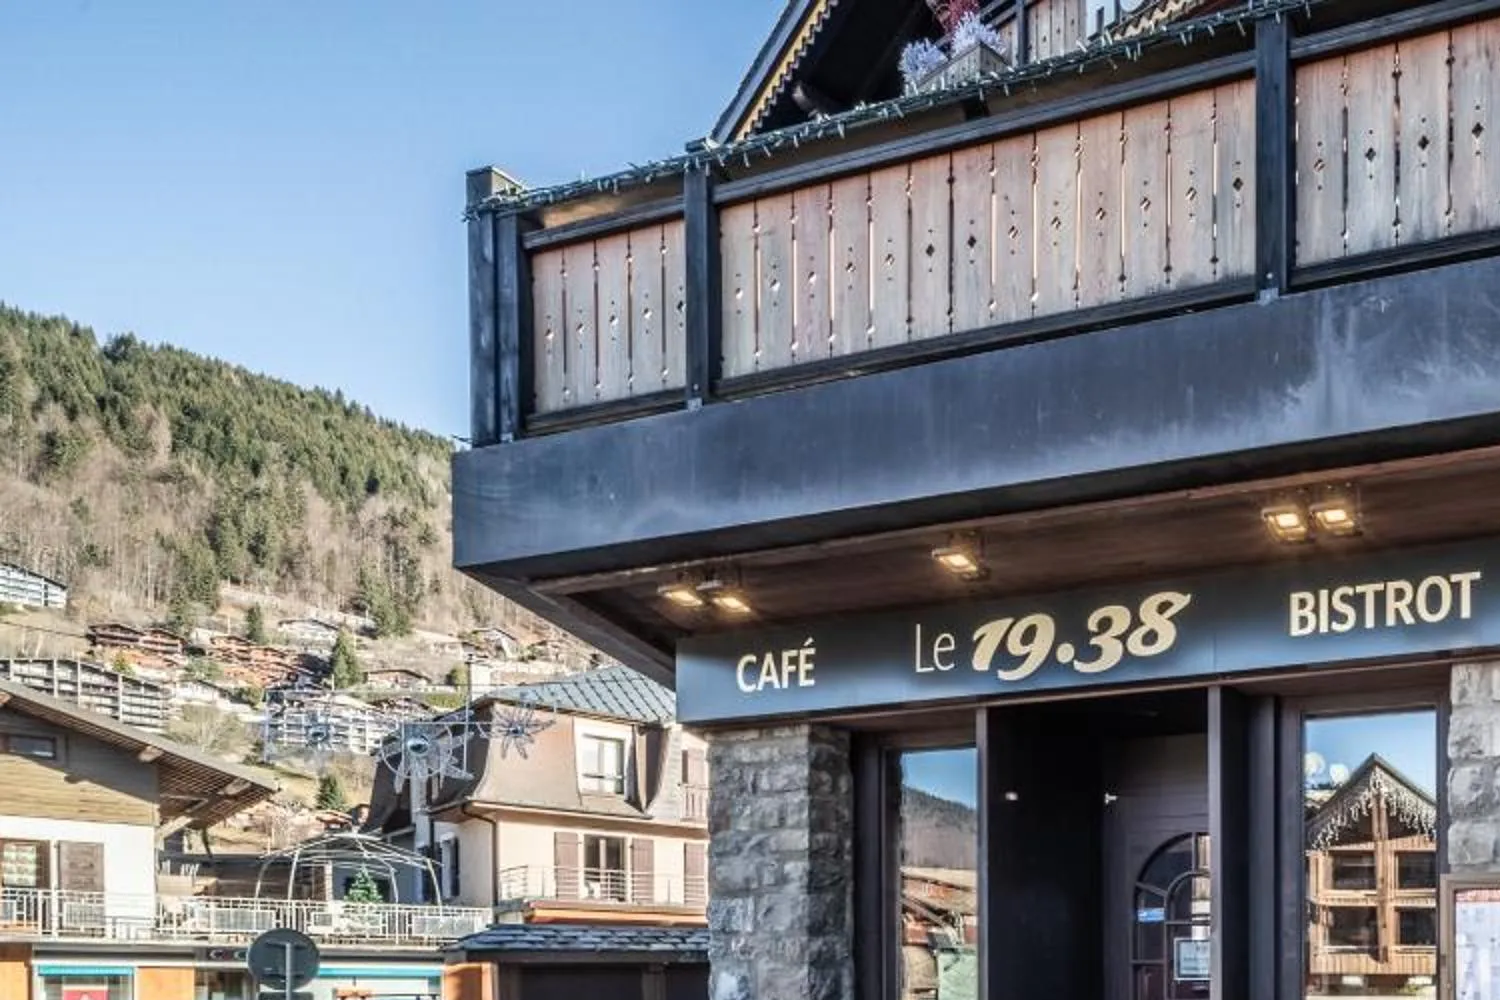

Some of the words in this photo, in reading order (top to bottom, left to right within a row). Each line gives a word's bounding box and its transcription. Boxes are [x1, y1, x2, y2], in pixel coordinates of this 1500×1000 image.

[736, 636, 817, 693] CAFÉ
[915, 623, 956, 674] Le
[971, 591, 1192, 681] 19.38
[1289, 570, 1483, 638] BISTROT
